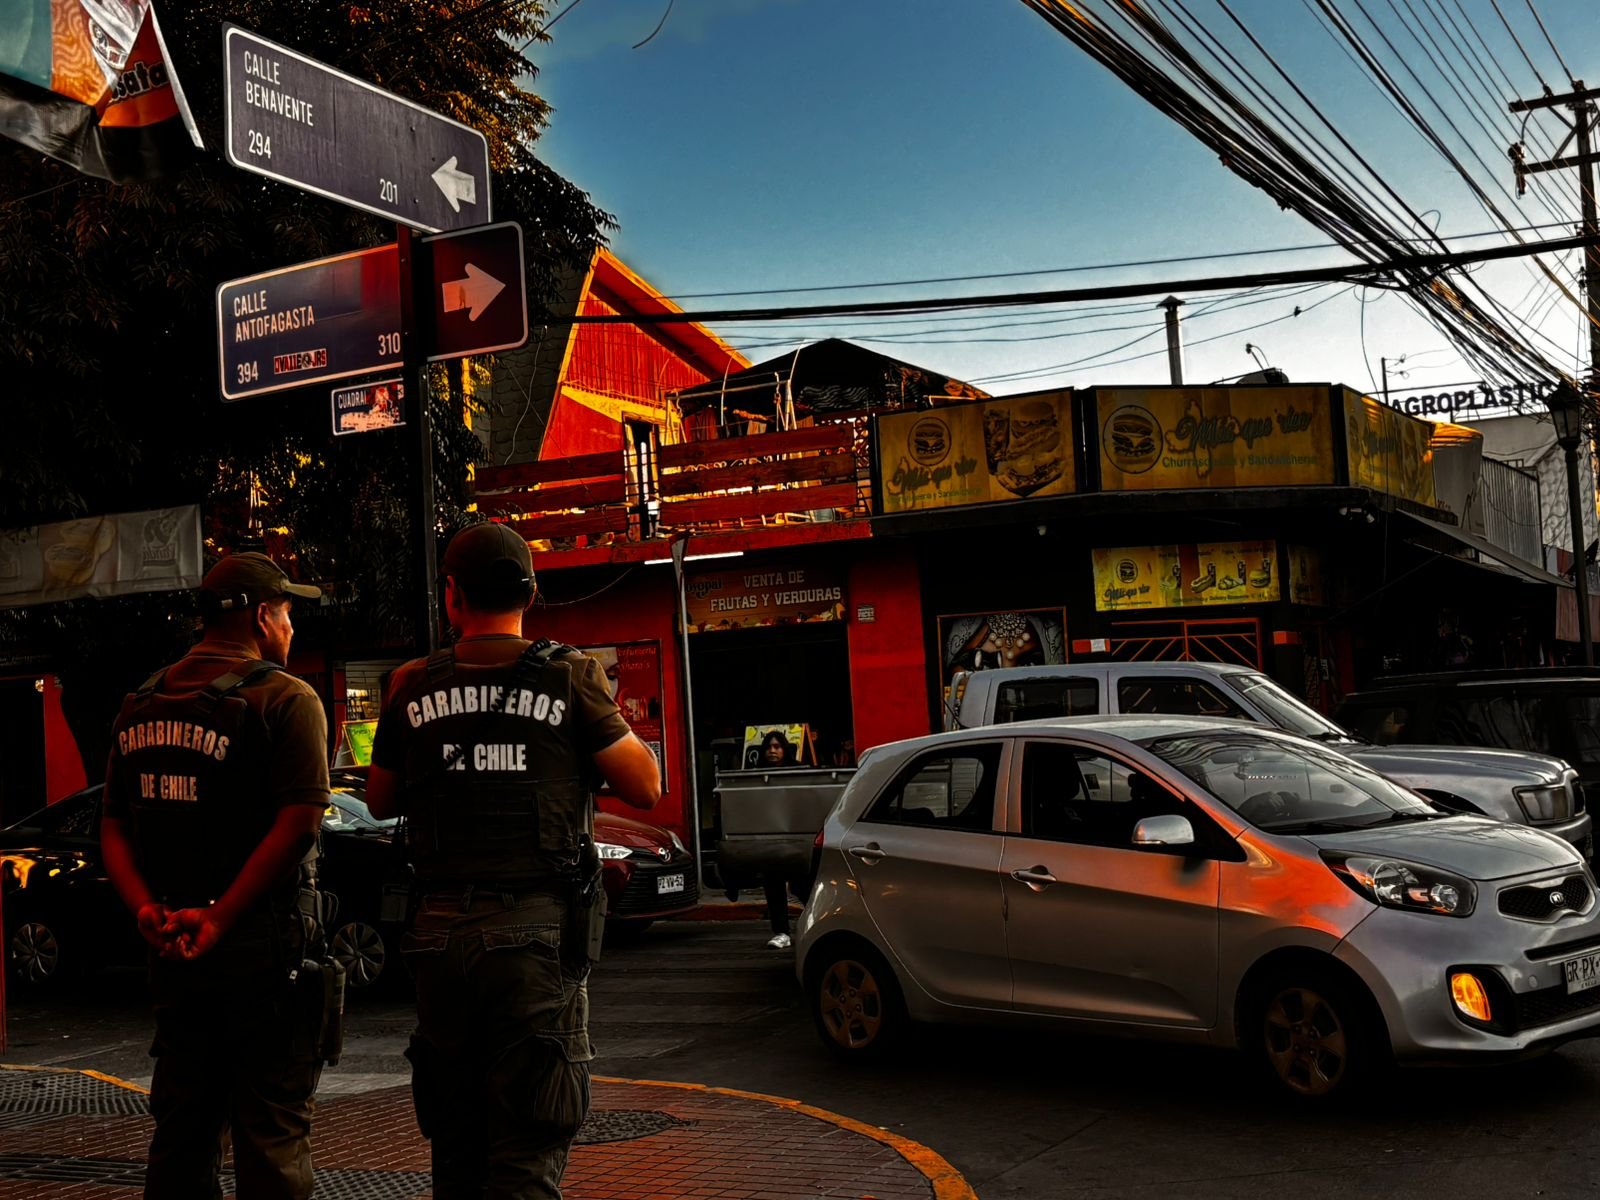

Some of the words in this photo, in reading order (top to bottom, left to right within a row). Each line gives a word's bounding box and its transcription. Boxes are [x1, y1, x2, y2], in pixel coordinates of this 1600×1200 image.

[244, 50, 280, 85] CALLE
[245, 80, 314, 127] BENAVENTE
[248, 129, 272, 159] 294
[379, 178, 399, 205] 201
[233, 290, 267, 318] CALLE
[235, 305, 315, 343] ANTOFAGASTA
[378, 332, 401, 356] 310
[237, 361, 259, 385] 394
[743, 572, 785, 588] VENTA
[788, 570, 805, 585] DE
[710, 594, 758, 612] FRUTAS
[761, 593, 770, 607] Y
[774, 586, 841, 606] VERDURAS
[406, 685, 566, 729] CARABINEROS
[118, 720, 230, 761] CARABINEROS
[473, 743, 527, 771] CHILE
[140, 772, 156, 799] DE
[160, 774, 198, 802] CHILE
